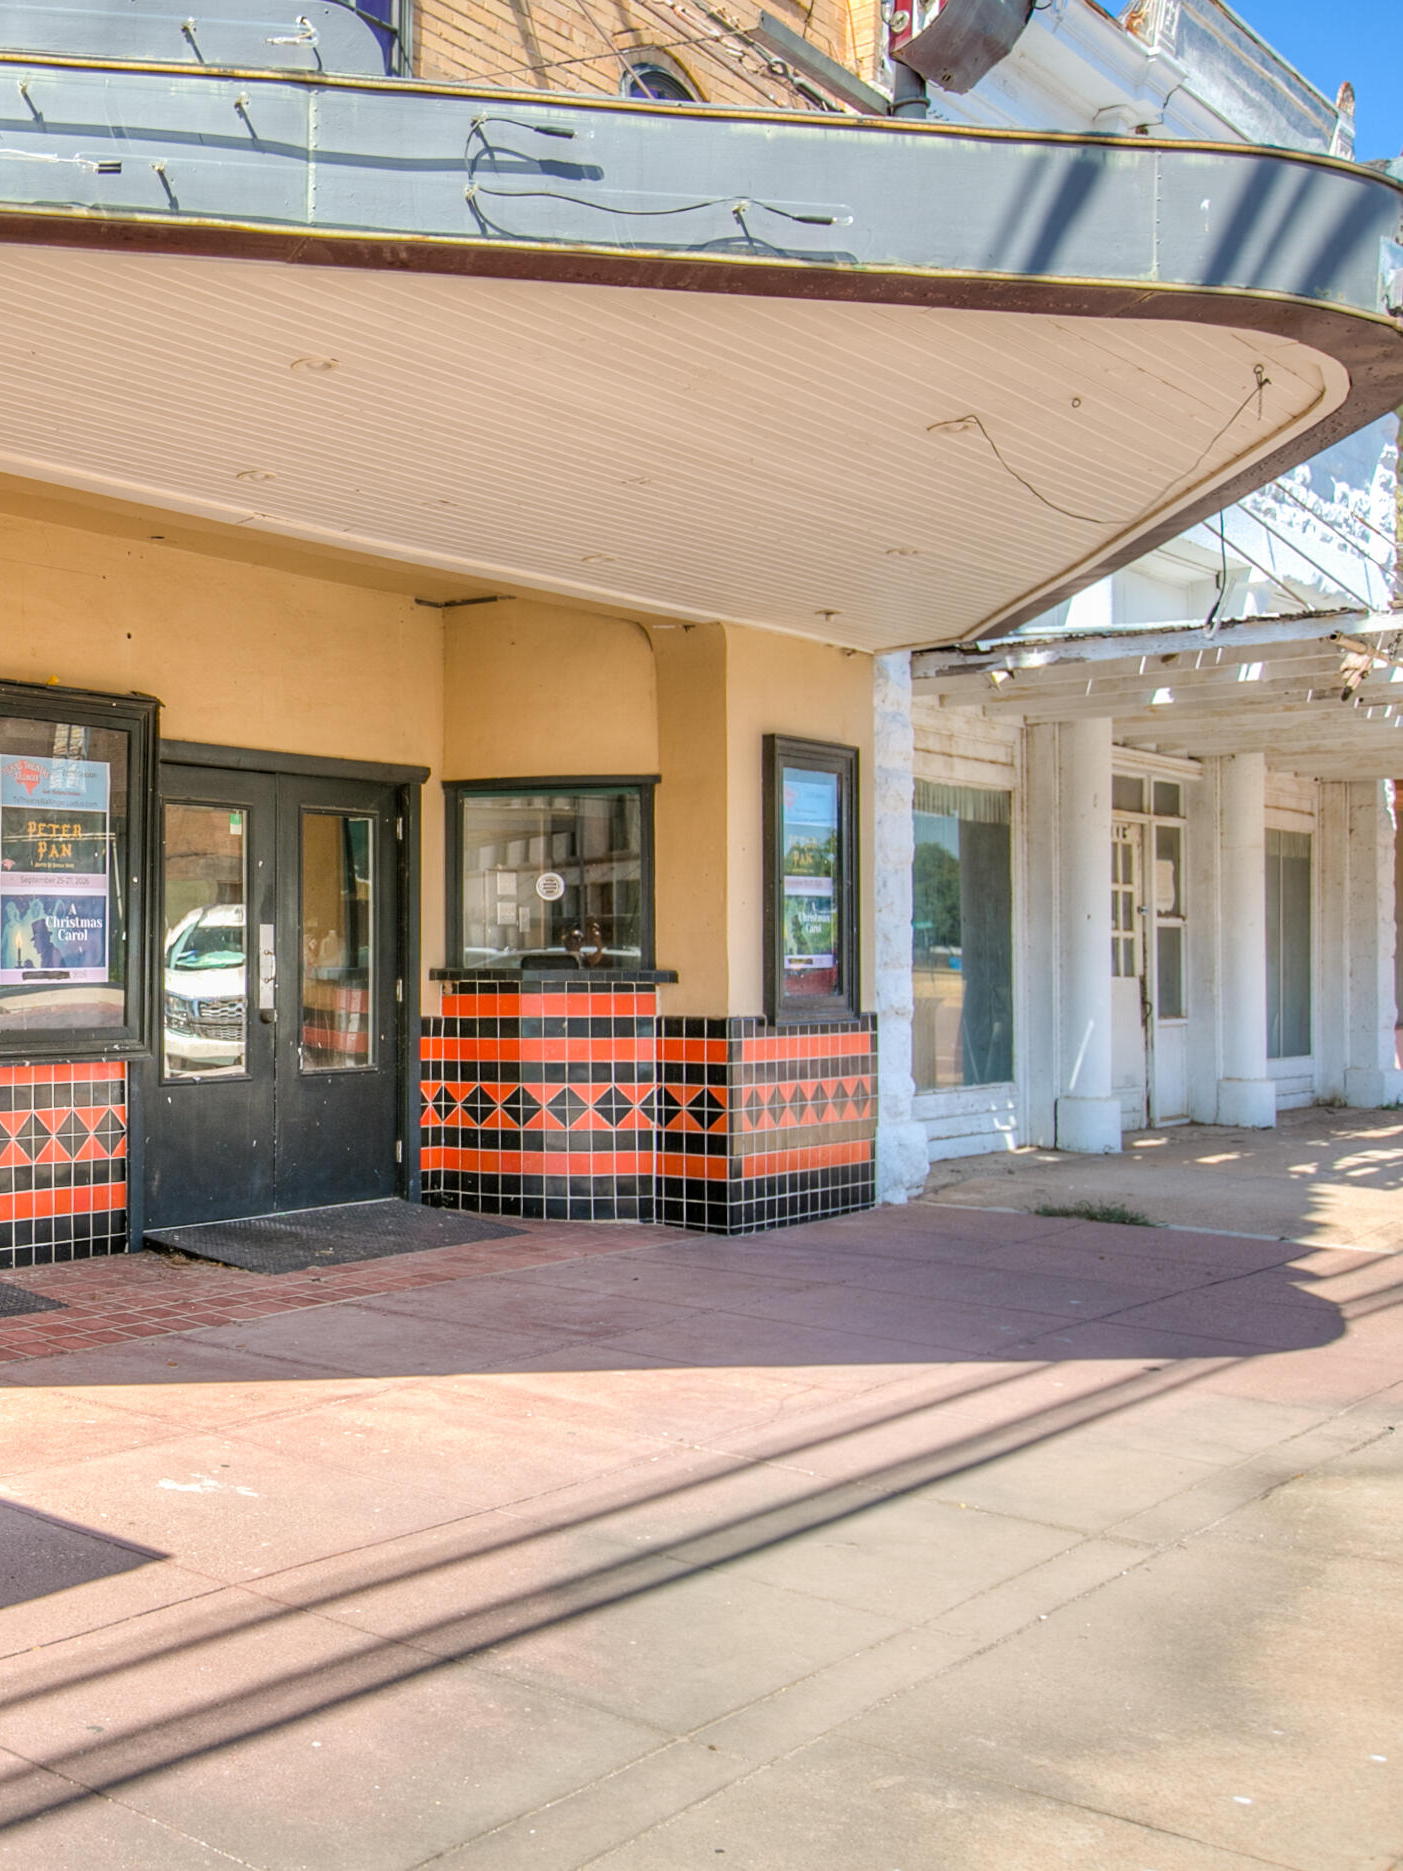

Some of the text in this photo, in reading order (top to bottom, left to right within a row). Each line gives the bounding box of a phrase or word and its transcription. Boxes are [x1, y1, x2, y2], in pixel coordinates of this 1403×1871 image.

[27, 820, 82, 840] PETER
[37, 841, 72, 861] PAN
[19, 876, 56, 885] September
[68, 903, 76, 915] A
[45, 915, 103, 929] Christmas
[57, 928, 88, 941] Carol
